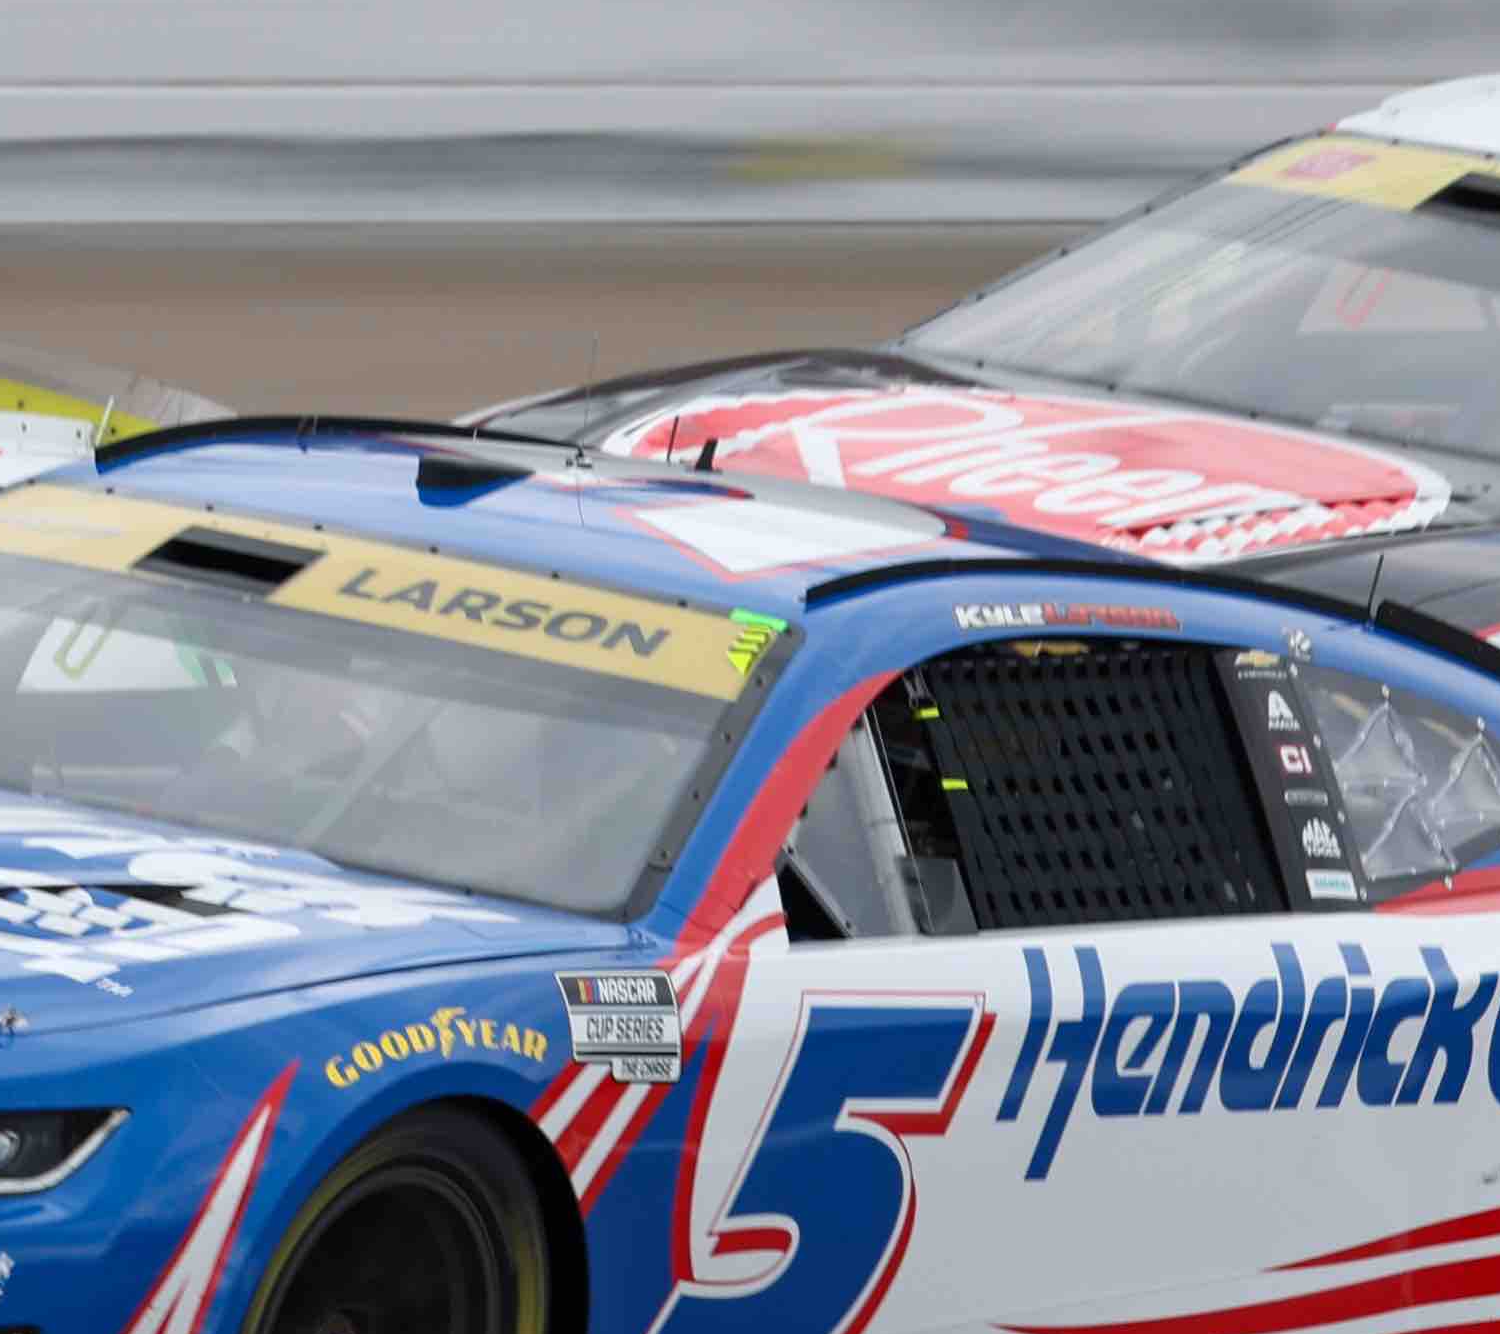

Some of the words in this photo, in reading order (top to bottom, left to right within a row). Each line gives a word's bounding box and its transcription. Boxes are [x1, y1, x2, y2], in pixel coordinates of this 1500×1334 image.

[337, 568, 672, 659] LARSON
[598, 978, 658, 1004] NASCAR
[325, 1006, 548, 1089] GOODYEAR
[587, 1017, 614, 1041] CUP
[616, 1017, 664, 1041] SERIES
